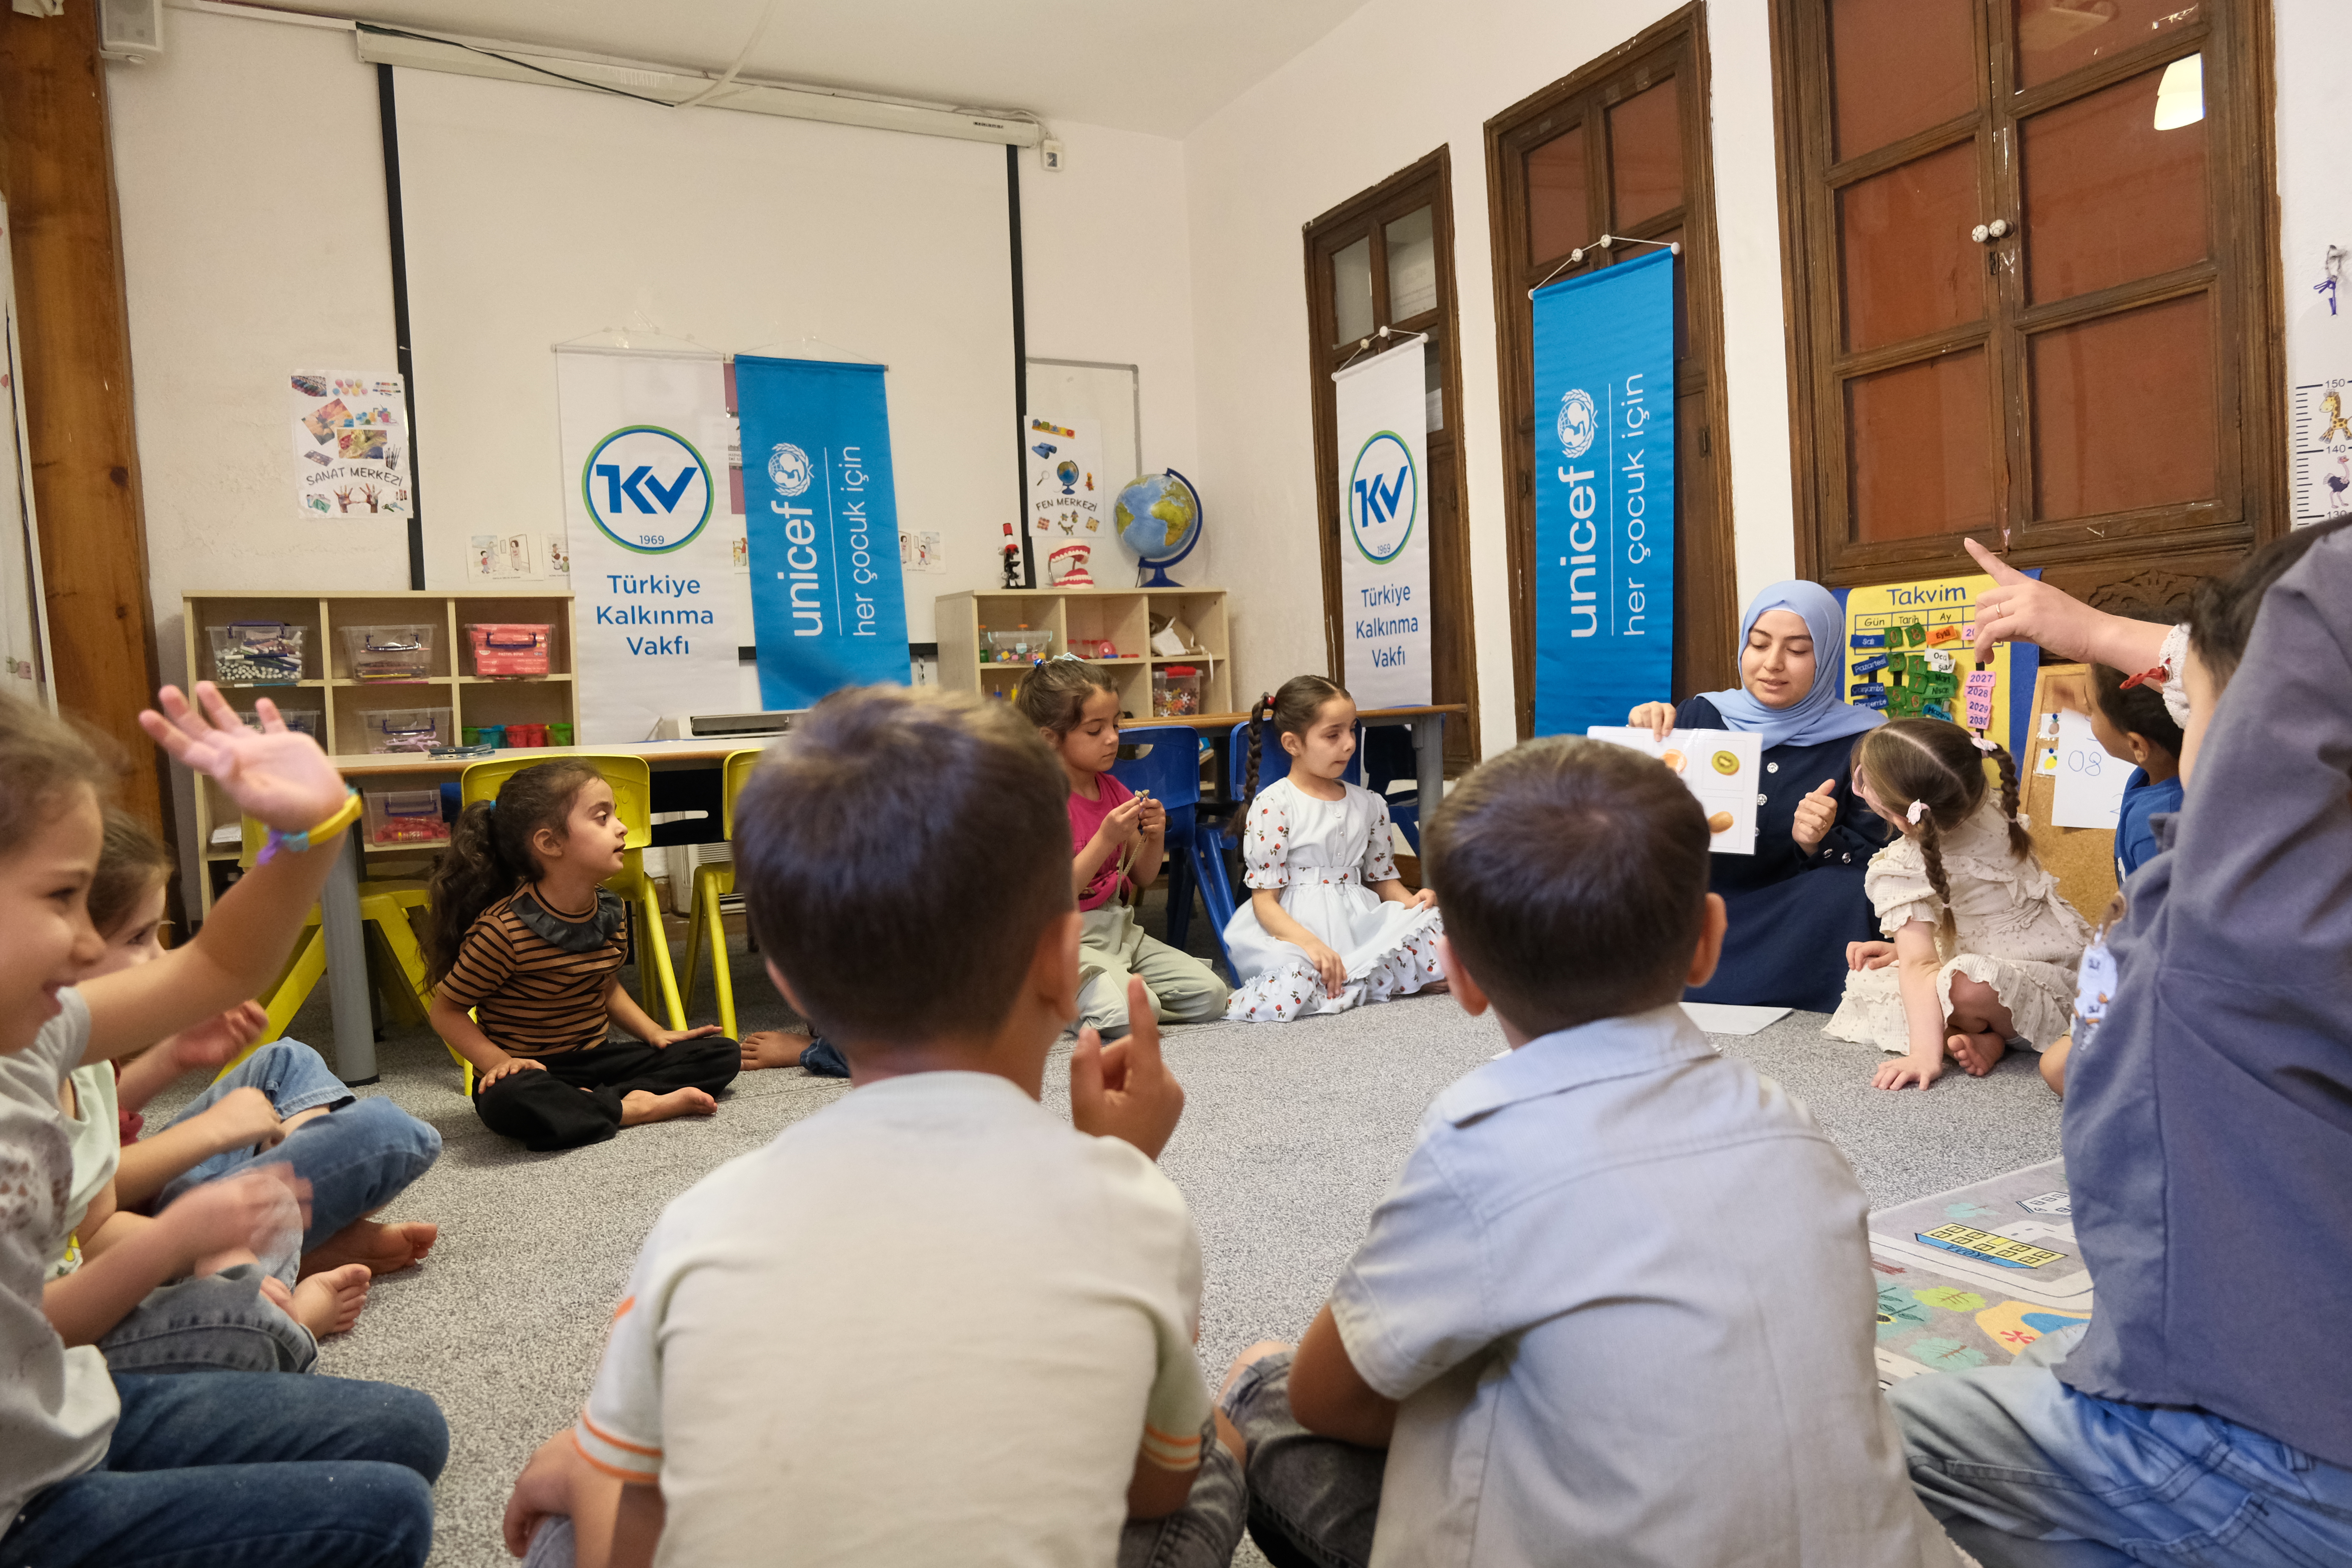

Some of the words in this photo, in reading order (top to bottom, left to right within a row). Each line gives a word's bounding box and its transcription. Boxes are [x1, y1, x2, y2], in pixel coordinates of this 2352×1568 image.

[2325, 378, 2345, 388] 150
[1621, 374, 1649, 438] için
[2326, 444, 2346, 454] 140
[306, 467, 345, 485] SANAT
[351, 467, 403, 486] MERKEZİ
[840, 446, 869, 494] için
[1036, 499, 1054, 511] FEN
[1057, 498, 1097, 512] MERKEZİ
[1622, 449, 1651, 564] çocuk
[2327, 510, 2347, 519] 130
[640, 535, 664, 544] 1969
[842, 501, 877, 584] çocuk
[1378, 544, 1390, 554] 1969
[1558, 466, 1597, 637] unicef
[771, 501, 822, 637] unicef
[607, 575, 700, 597] Türkiye
[1361, 584, 1410, 607] Türkiye
[1886, 585, 1966, 605] Takvim
[597, 606, 713, 625] Kalkınma
[853, 595, 876, 635] her
[1623, 577, 1645, 635] her
[1357, 617, 1418, 639] Kalkınma
[1865, 618, 1884, 626] Gün
[1899, 615, 1919, 624] Tarih
[1940, 613, 1951, 622] Ay
[626, 635, 689, 655] Vakfı
[1372, 645, 1405, 668] Vakfı
[1854, 657, 1886, 673] Pazartesi
[1914, 676, 1921, 688] 7
[1893, 689, 1900, 701] 5
[1911, 695, 1919, 707] 6
[1968, 686, 1988, 698] 2028
[1969, 701, 1988, 714] 2029
[1969, 716, 1987, 726] 2030
[2069, 750, 2101, 776] 08
